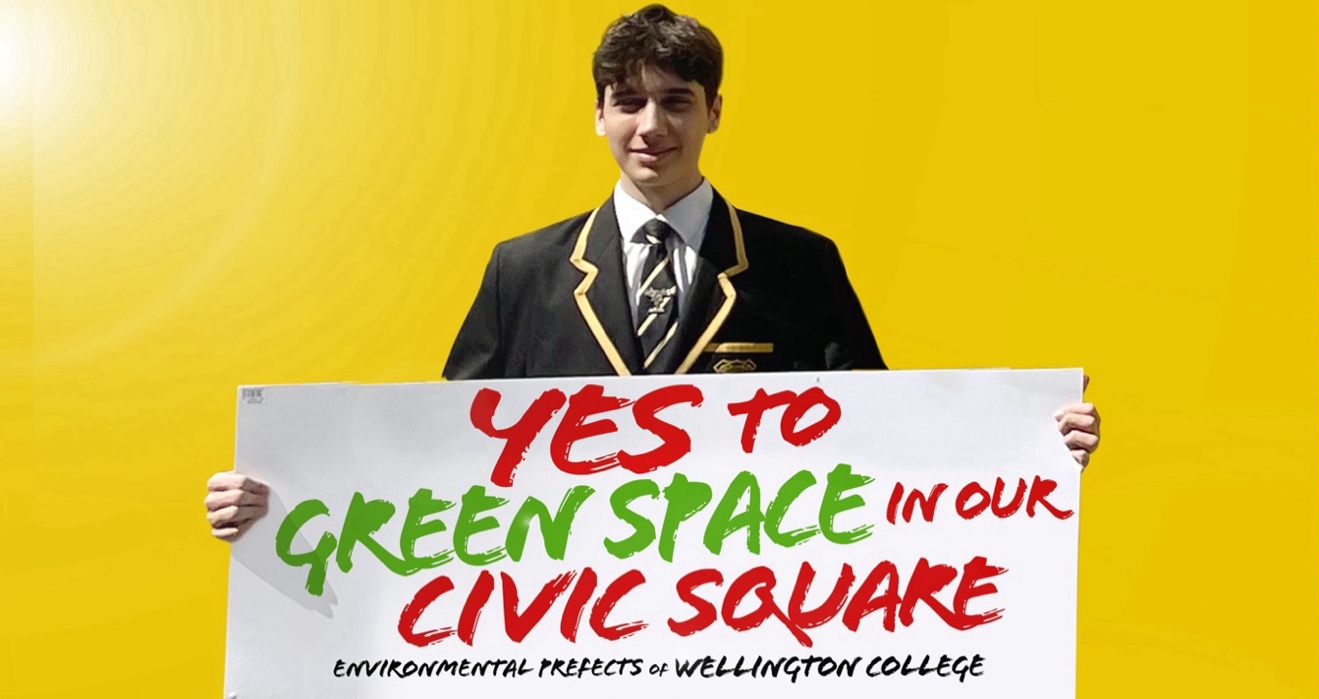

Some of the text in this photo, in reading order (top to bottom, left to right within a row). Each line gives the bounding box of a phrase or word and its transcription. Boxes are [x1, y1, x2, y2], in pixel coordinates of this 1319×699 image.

[470, 383, 842, 488] YES TO
[275, 463, 1075, 598] GREEN SPACE IN OUR
[398, 556, 1007, 648] CIVIC SQUARE
[334, 658, 533, 679] ENVIRONMENTAL
[538, 657, 644, 679] PREFECTS
[675, 654, 862, 684] WELLINGTON
[865, 653, 985, 683] COLLEGE
